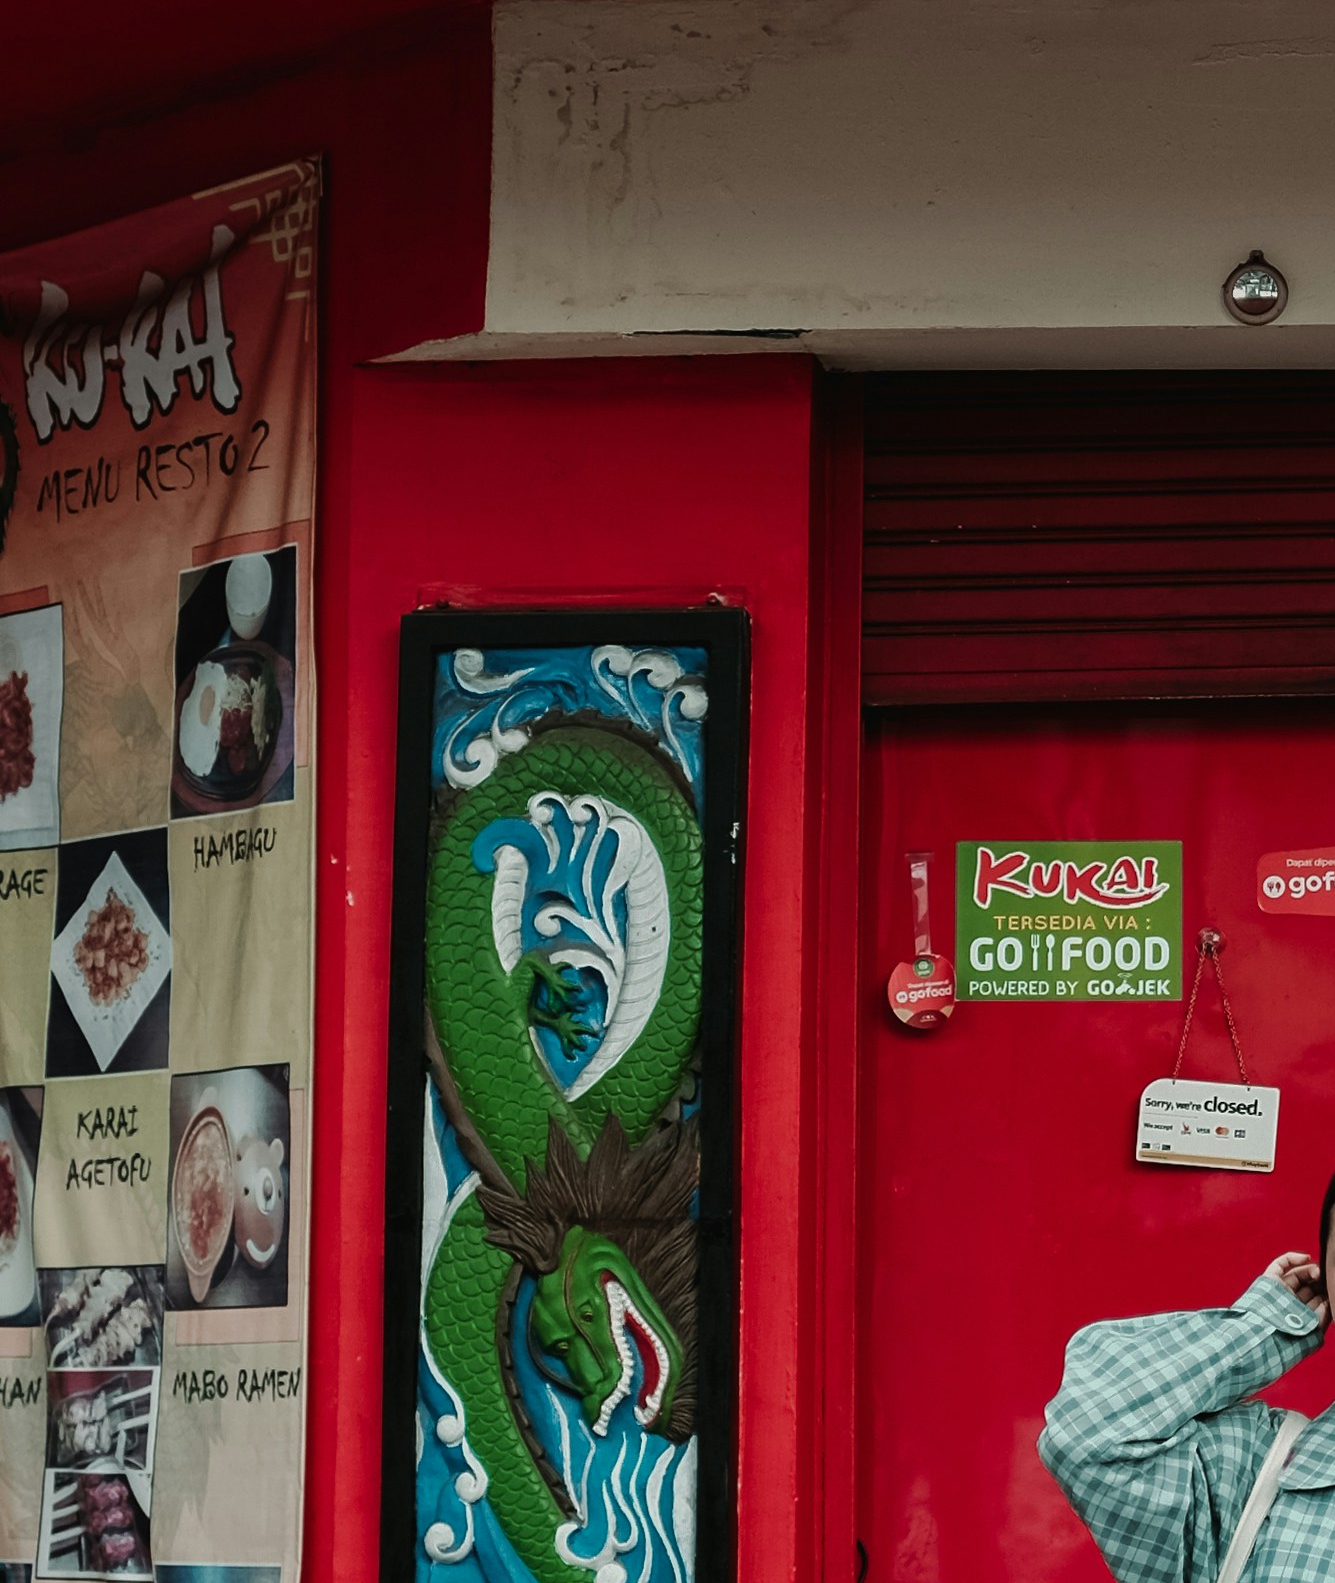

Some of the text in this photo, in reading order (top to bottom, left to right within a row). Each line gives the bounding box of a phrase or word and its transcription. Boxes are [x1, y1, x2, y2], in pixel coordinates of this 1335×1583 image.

[37, 419, 270, 523] MENU RESTO 2
[193, 827, 277, 870] HAMBAGU
[973, 847, 1170, 909] KUKAI
[993, 915, 1096, 931] TERSEDIA
[1103, 915, 1139, 931] VIA
[908, 984, 953, 1003] gofood
[969, 980, 1050, 996] POWERED
[1055, 980, 1079, 996] BY
[77, 1105, 138, 1140] KARAI
[1145, 1096, 1263, 1117] Sorry, we're closed.
[66, 1153, 152, 1191] AGETOFU
[173, 1367, 301, 1405] MABO RAMEN
